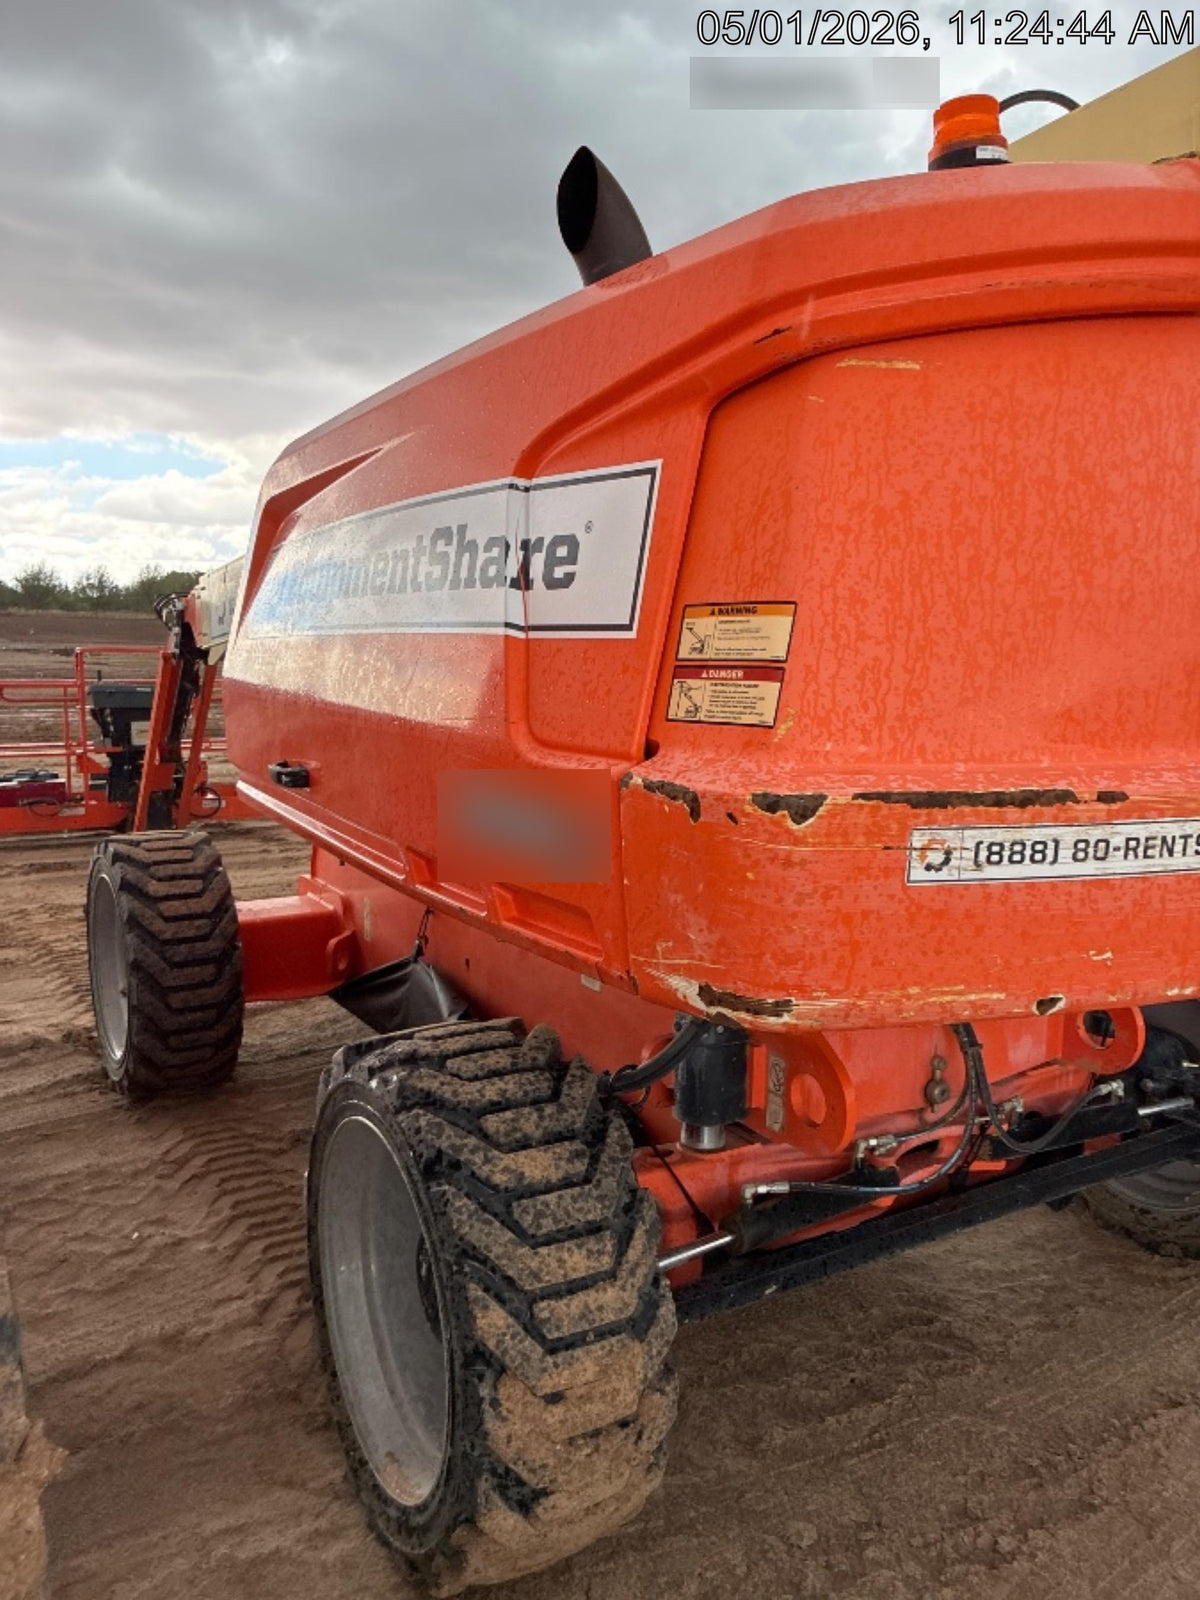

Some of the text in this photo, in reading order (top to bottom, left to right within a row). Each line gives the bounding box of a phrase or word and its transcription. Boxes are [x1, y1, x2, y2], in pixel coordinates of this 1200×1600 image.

[717, 606, 758, 616] WARNING
[708, 670, 744, 679] DANGER
[972, 837, 1060, 868] (888)
